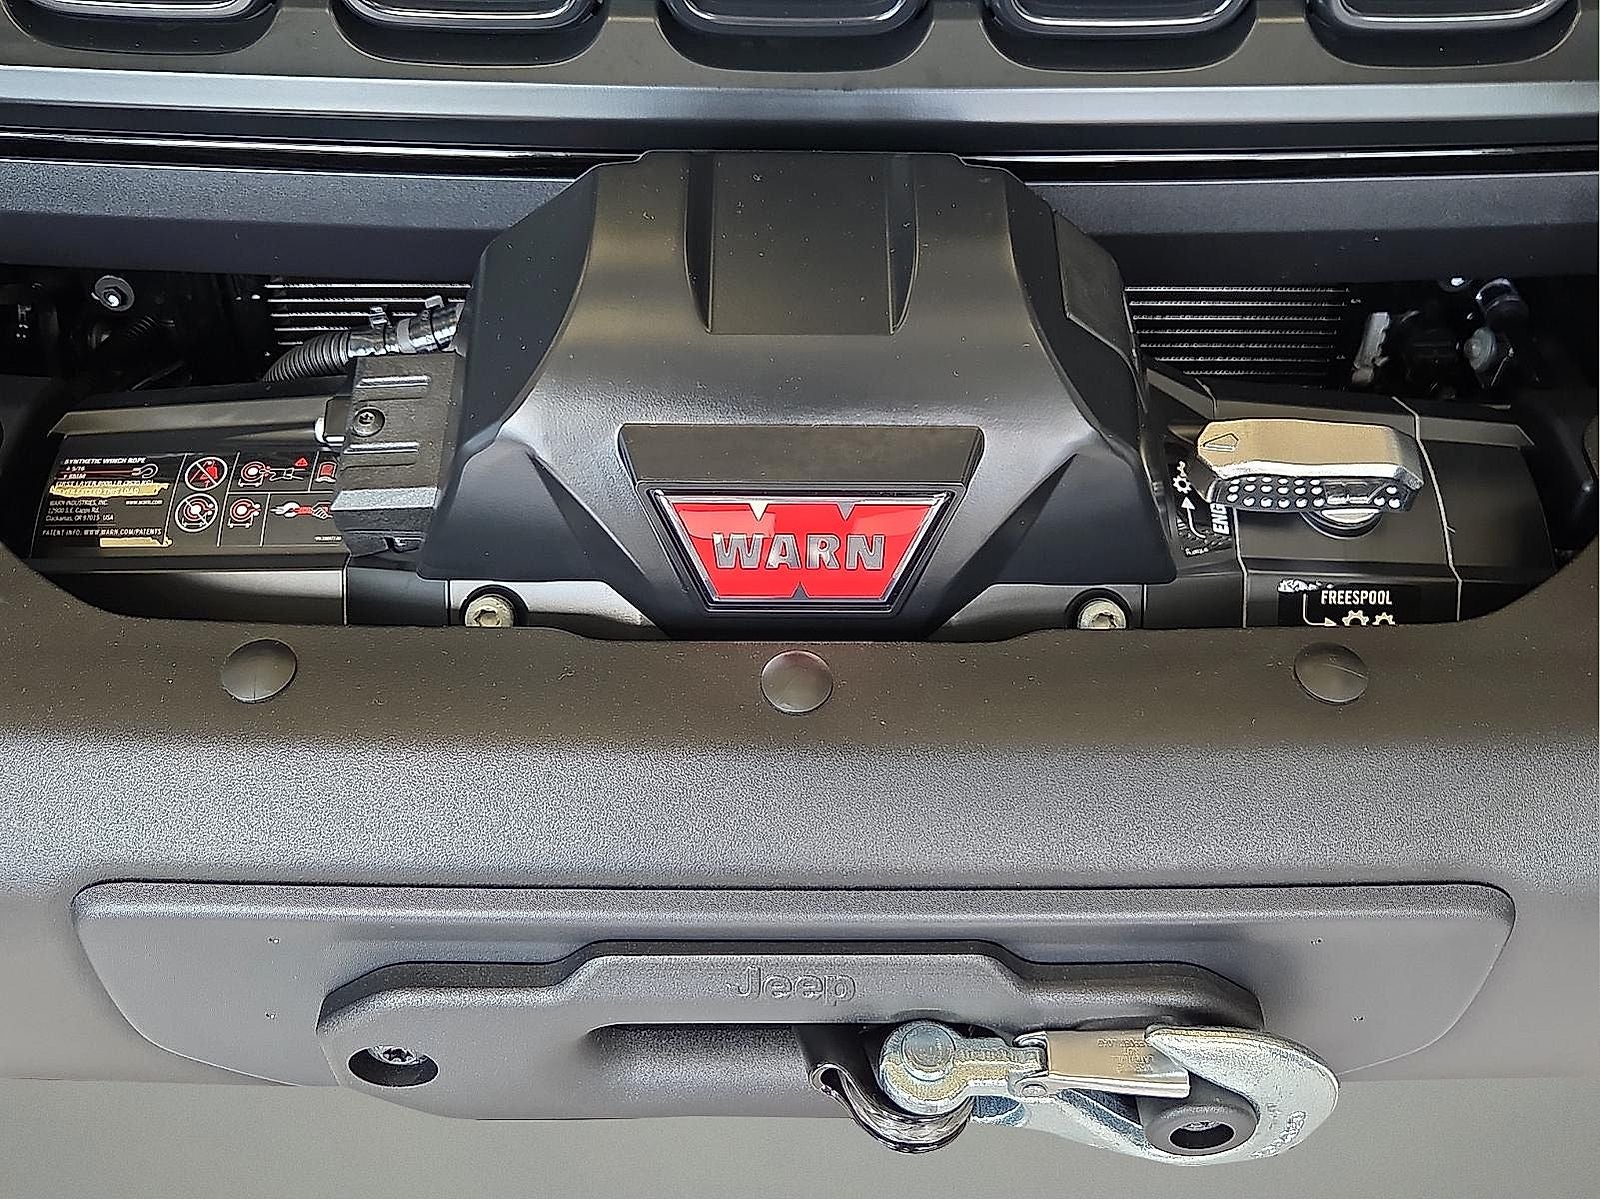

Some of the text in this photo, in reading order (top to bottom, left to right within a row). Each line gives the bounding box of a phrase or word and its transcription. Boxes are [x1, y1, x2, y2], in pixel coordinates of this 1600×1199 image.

[103, 457, 127, 465] WINCH
[42, 529, 66, 537] PATENT
[83, 528, 162, 536] WWW.WARN.COM/PATENTS
[711, 532, 886, 571] WARN
[1320, 589, 1393, 606] FREESPOOL
[725, 965, 857, 1007] Jeep
